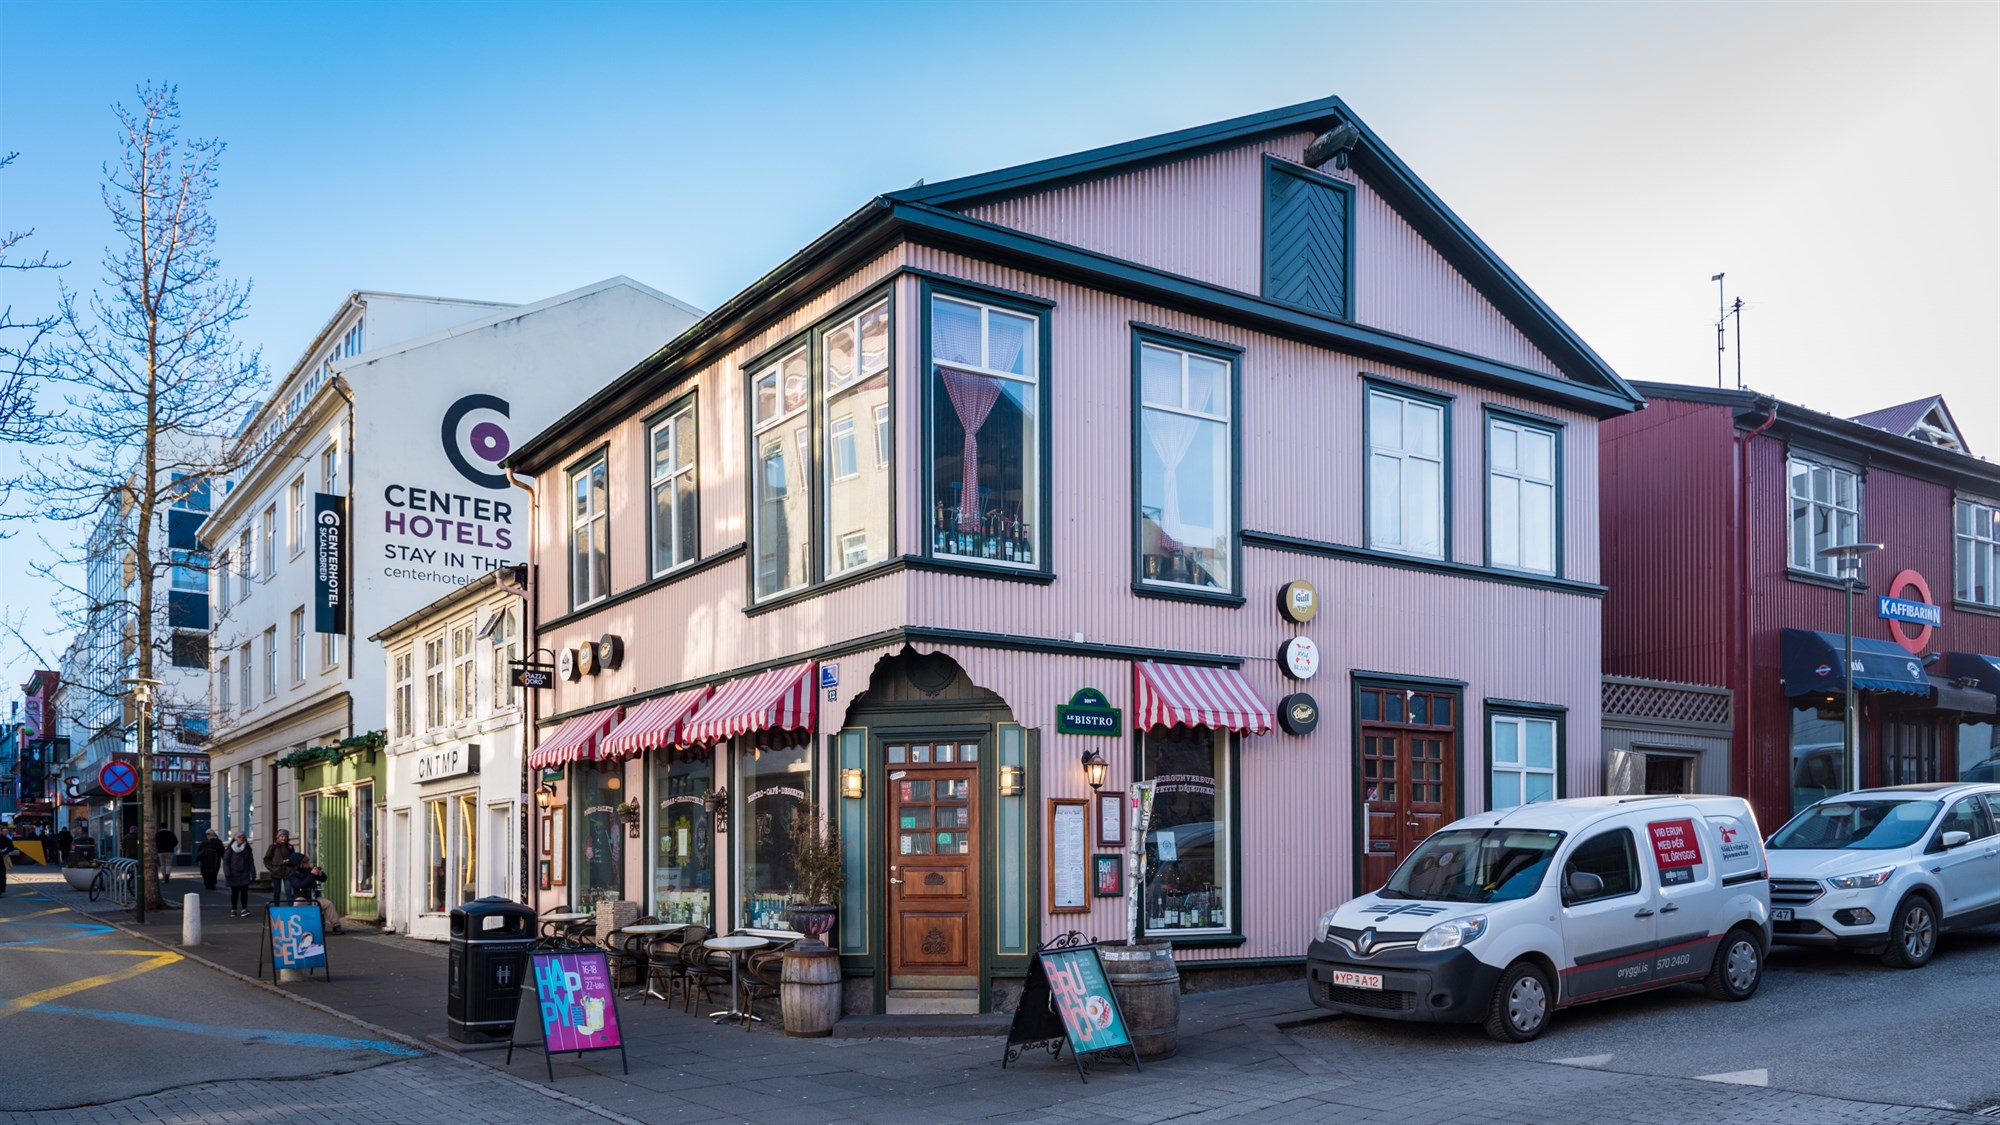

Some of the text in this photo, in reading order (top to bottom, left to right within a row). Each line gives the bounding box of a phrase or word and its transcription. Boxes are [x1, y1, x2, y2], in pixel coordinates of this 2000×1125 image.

[384, 484, 512, 524] CENTER
[385, 510, 512, 550] HOTELS
[328, 527, 338, 608] CENTERHOTEL
[384, 543, 436, 564] STAY
[444, 551, 464, 568] IN
[1295, 592, 1310, 602] Gull
[1881, 599, 1940, 624] KAFFIBARINN
[1074, 715, 1113, 727] BISTRO
[419, 751, 459, 778] CNTMP
[1666, 826, 1683, 837] ERUM
[1660, 852, 1672, 863] TIL
[1617, 953, 1690, 978] oryggi.is 570 2400
[1340, 973, 1379, 987] YP A12
